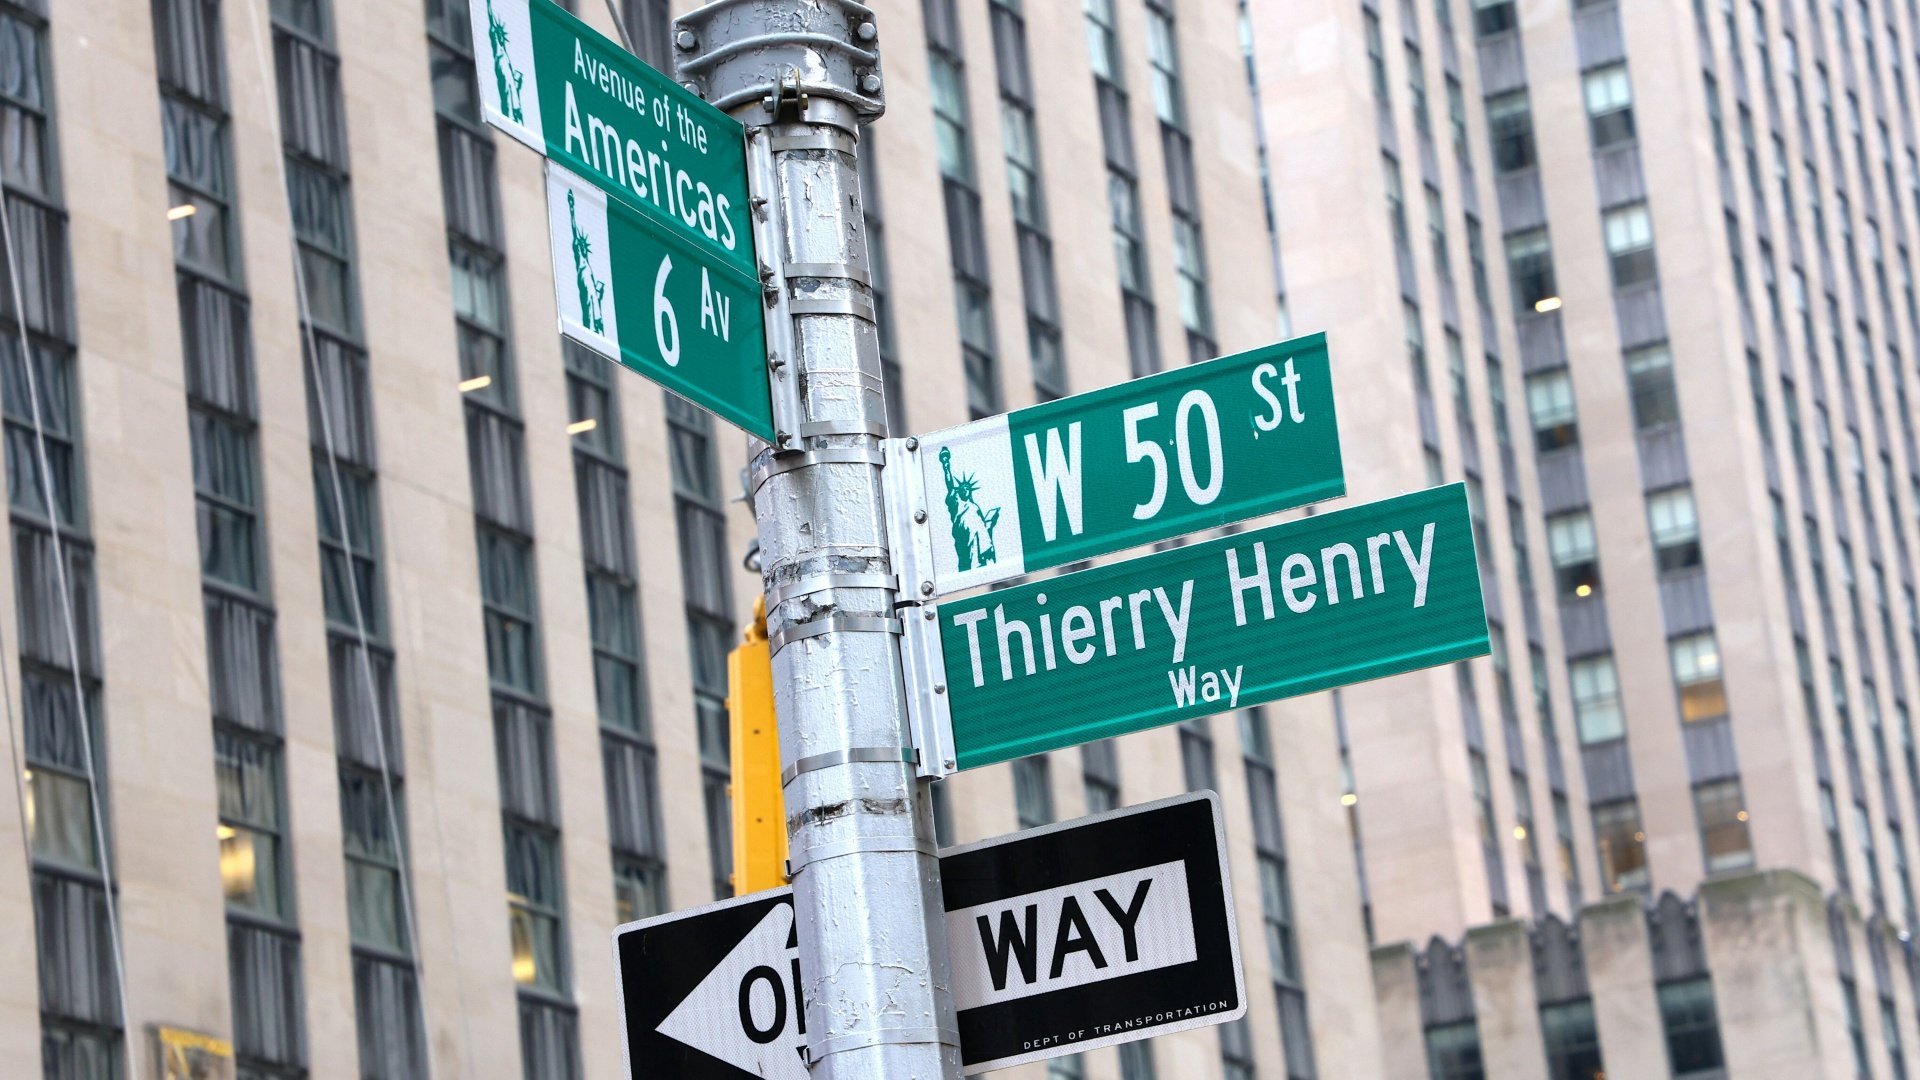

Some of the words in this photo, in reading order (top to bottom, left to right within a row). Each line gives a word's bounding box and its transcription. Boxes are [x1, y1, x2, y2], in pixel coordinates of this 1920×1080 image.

[565, 81, 736, 251] Americas
[574, 38, 645, 116] Avenue
[654, 97, 670, 133] of
[677, 111, 708, 154] the
[653, 254, 680, 367] 6
[701, 266, 730, 342] Av
[1023, 421, 1083, 542] W
[1122, 389, 1224, 520] 50
[1251, 357, 1305, 432] St
[953, 579, 1194, 688] Thierry
[1225, 522, 1435, 627] Henry
[1168, 665, 1243, 709] Way
[738, 958, 806, 1044] O
[976, 878, 1153, 991] WAY
[1023, 1035, 1059, 1050] DEPT
[1068, 1030, 1085, 1040] OF
[1094, 1000, 1228, 1035] TRANSPORTATION
